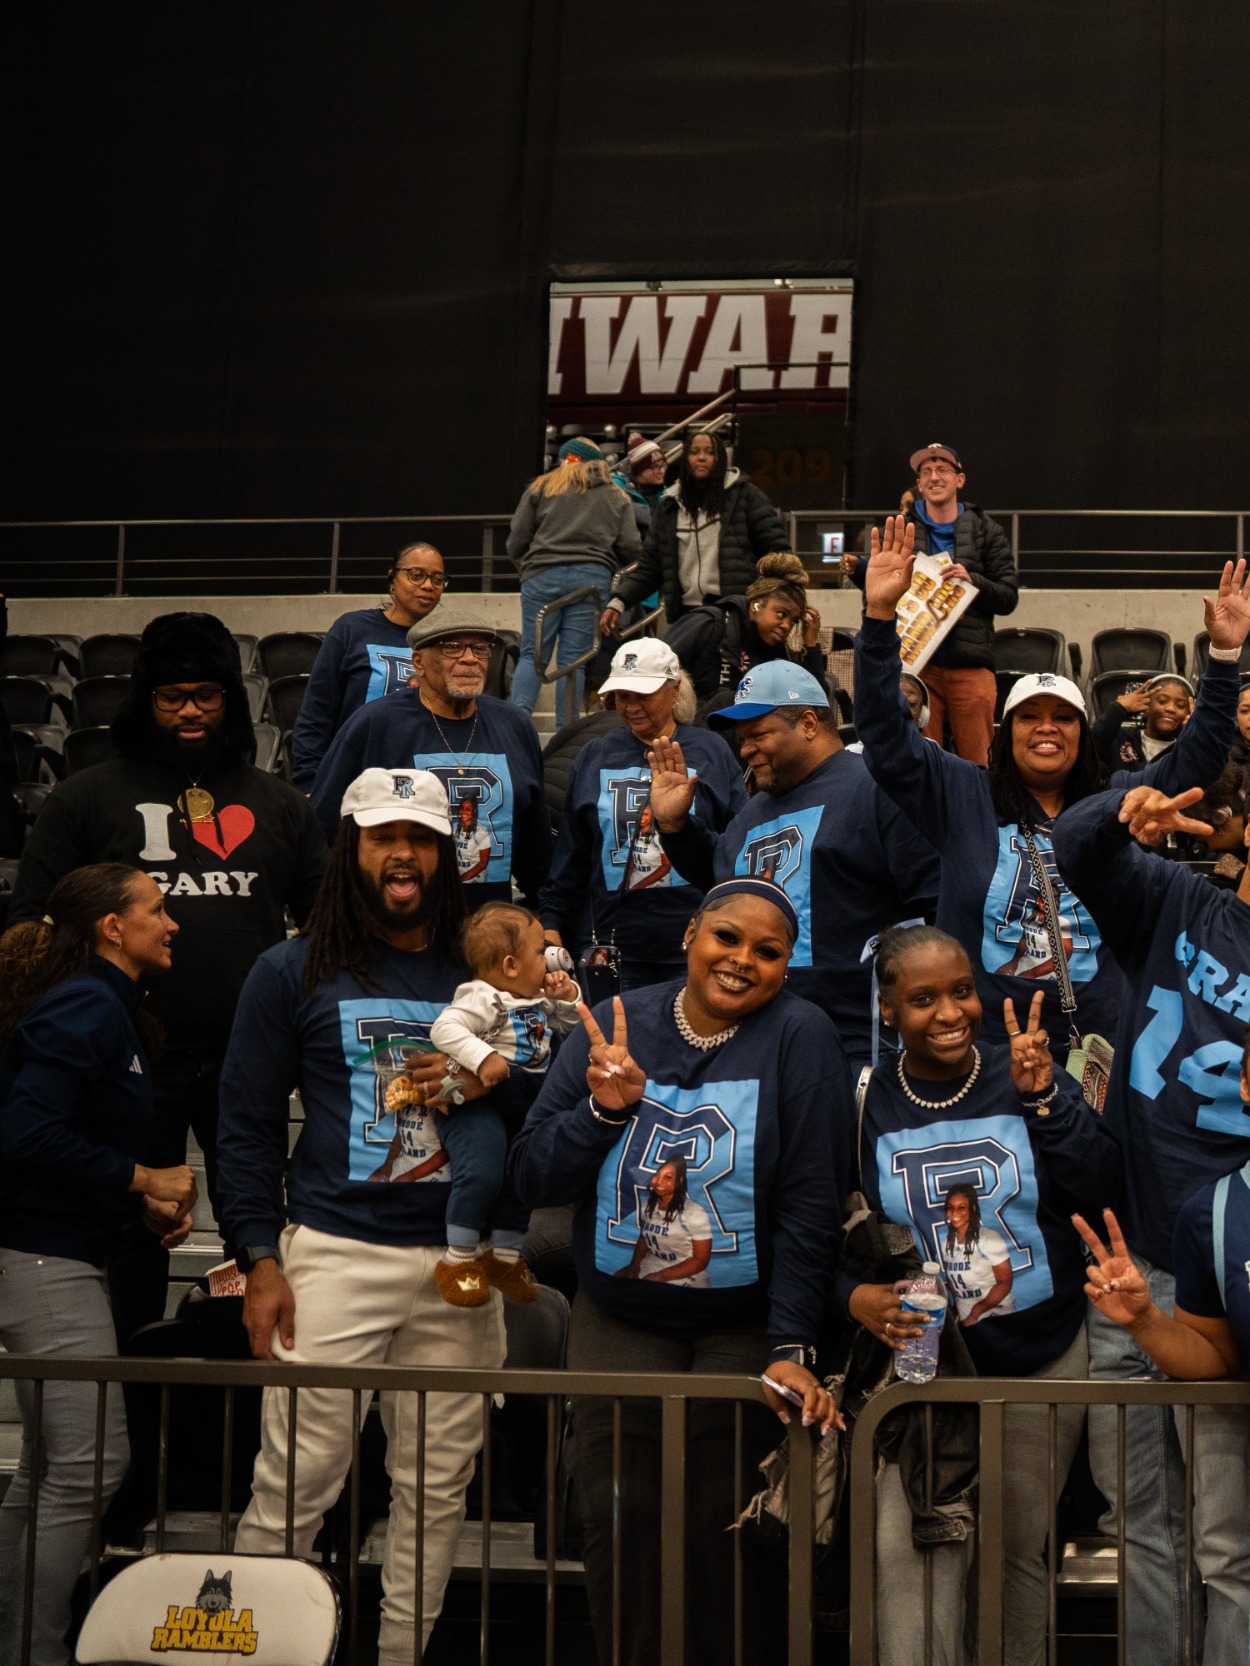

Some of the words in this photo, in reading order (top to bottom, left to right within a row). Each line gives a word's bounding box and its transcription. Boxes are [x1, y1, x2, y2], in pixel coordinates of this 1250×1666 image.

[135, 803, 177, 862] I
[147, 871, 259, 897] GARY
[164, 1604, 254, 1633] LOYOLA
[150, 1626, 259, 1656] RAMBLERS
